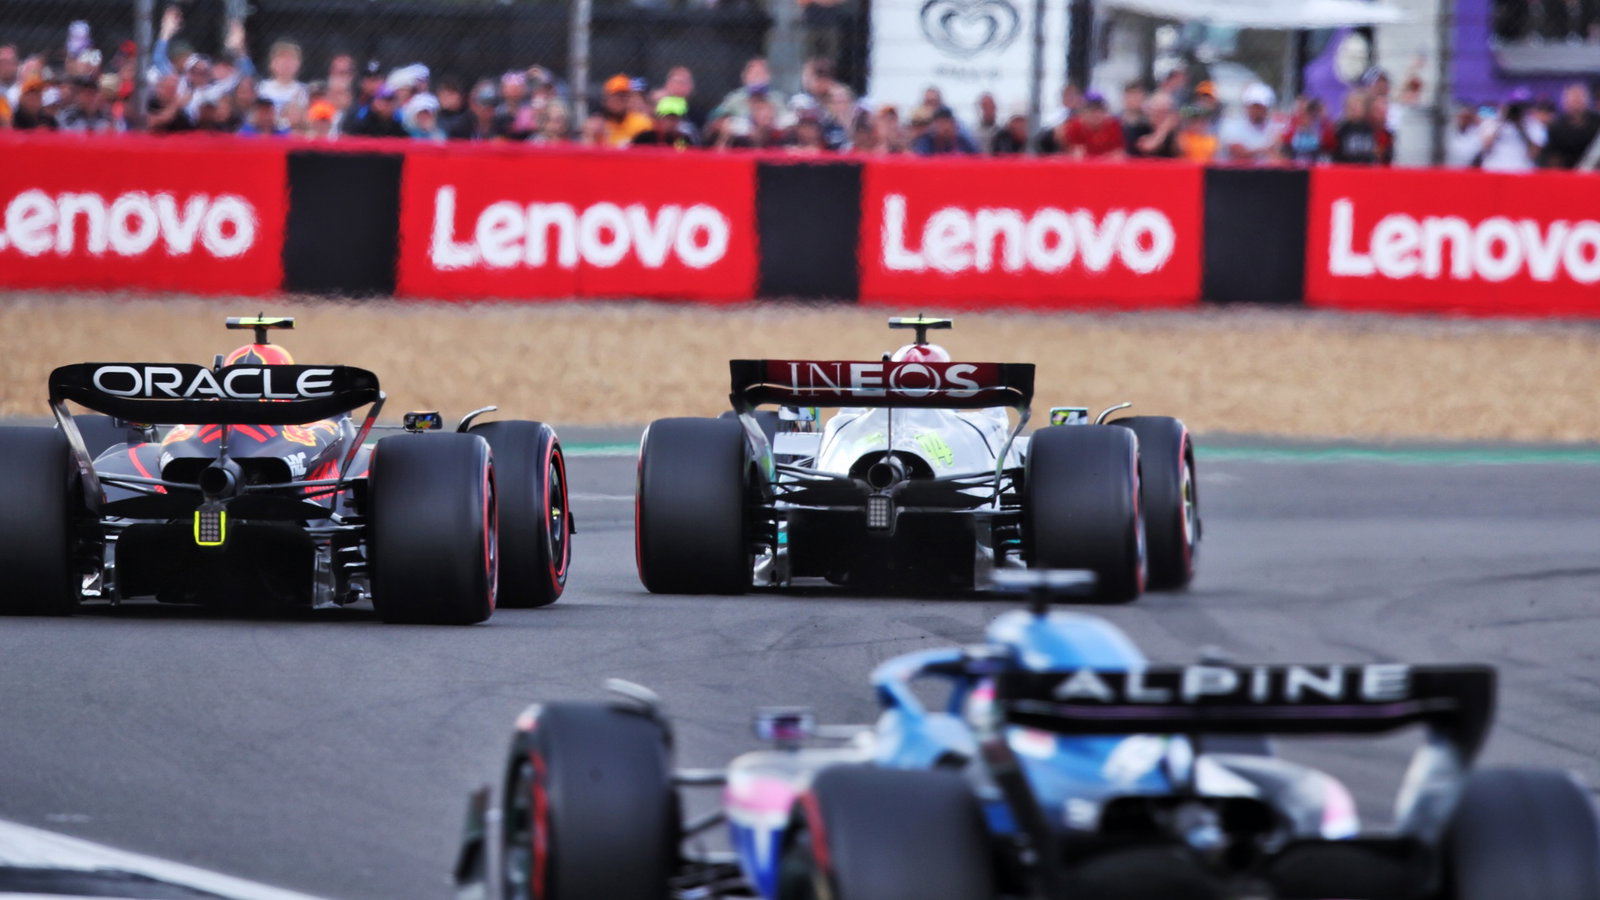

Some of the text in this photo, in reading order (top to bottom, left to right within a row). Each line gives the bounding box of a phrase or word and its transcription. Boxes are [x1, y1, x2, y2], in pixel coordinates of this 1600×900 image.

[0, 188, 257, 258] enovo
[430, 185, 730, 270] Lenovo
[882, 193, 1176, 274] Lenovo
[1328, 197, 1600, 284] Lenovo
[92, 365, 336, 398] ORACLE
[787, 362, 980, 398] INEOS
[1052, 664, 1411, 701] ALPINE
